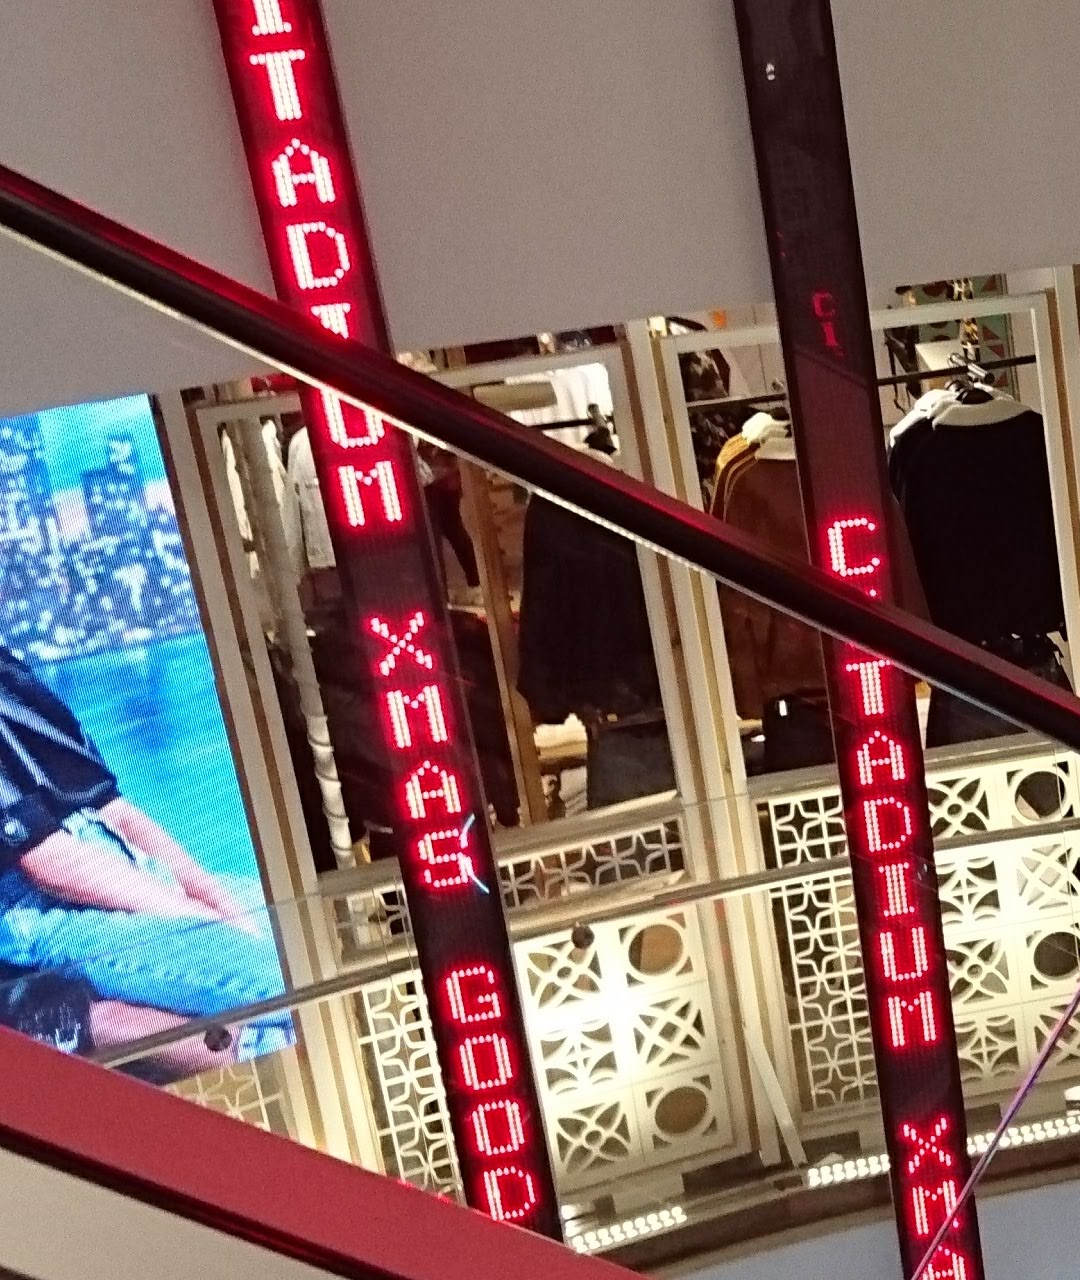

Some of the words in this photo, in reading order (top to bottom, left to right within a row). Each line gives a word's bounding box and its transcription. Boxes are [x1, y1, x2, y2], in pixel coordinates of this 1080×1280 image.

[371, 611, 471, 888] XMAS
[446, 967, 536, 1221] GOOD
[828, 518, 936, 1047] CTADIUM
